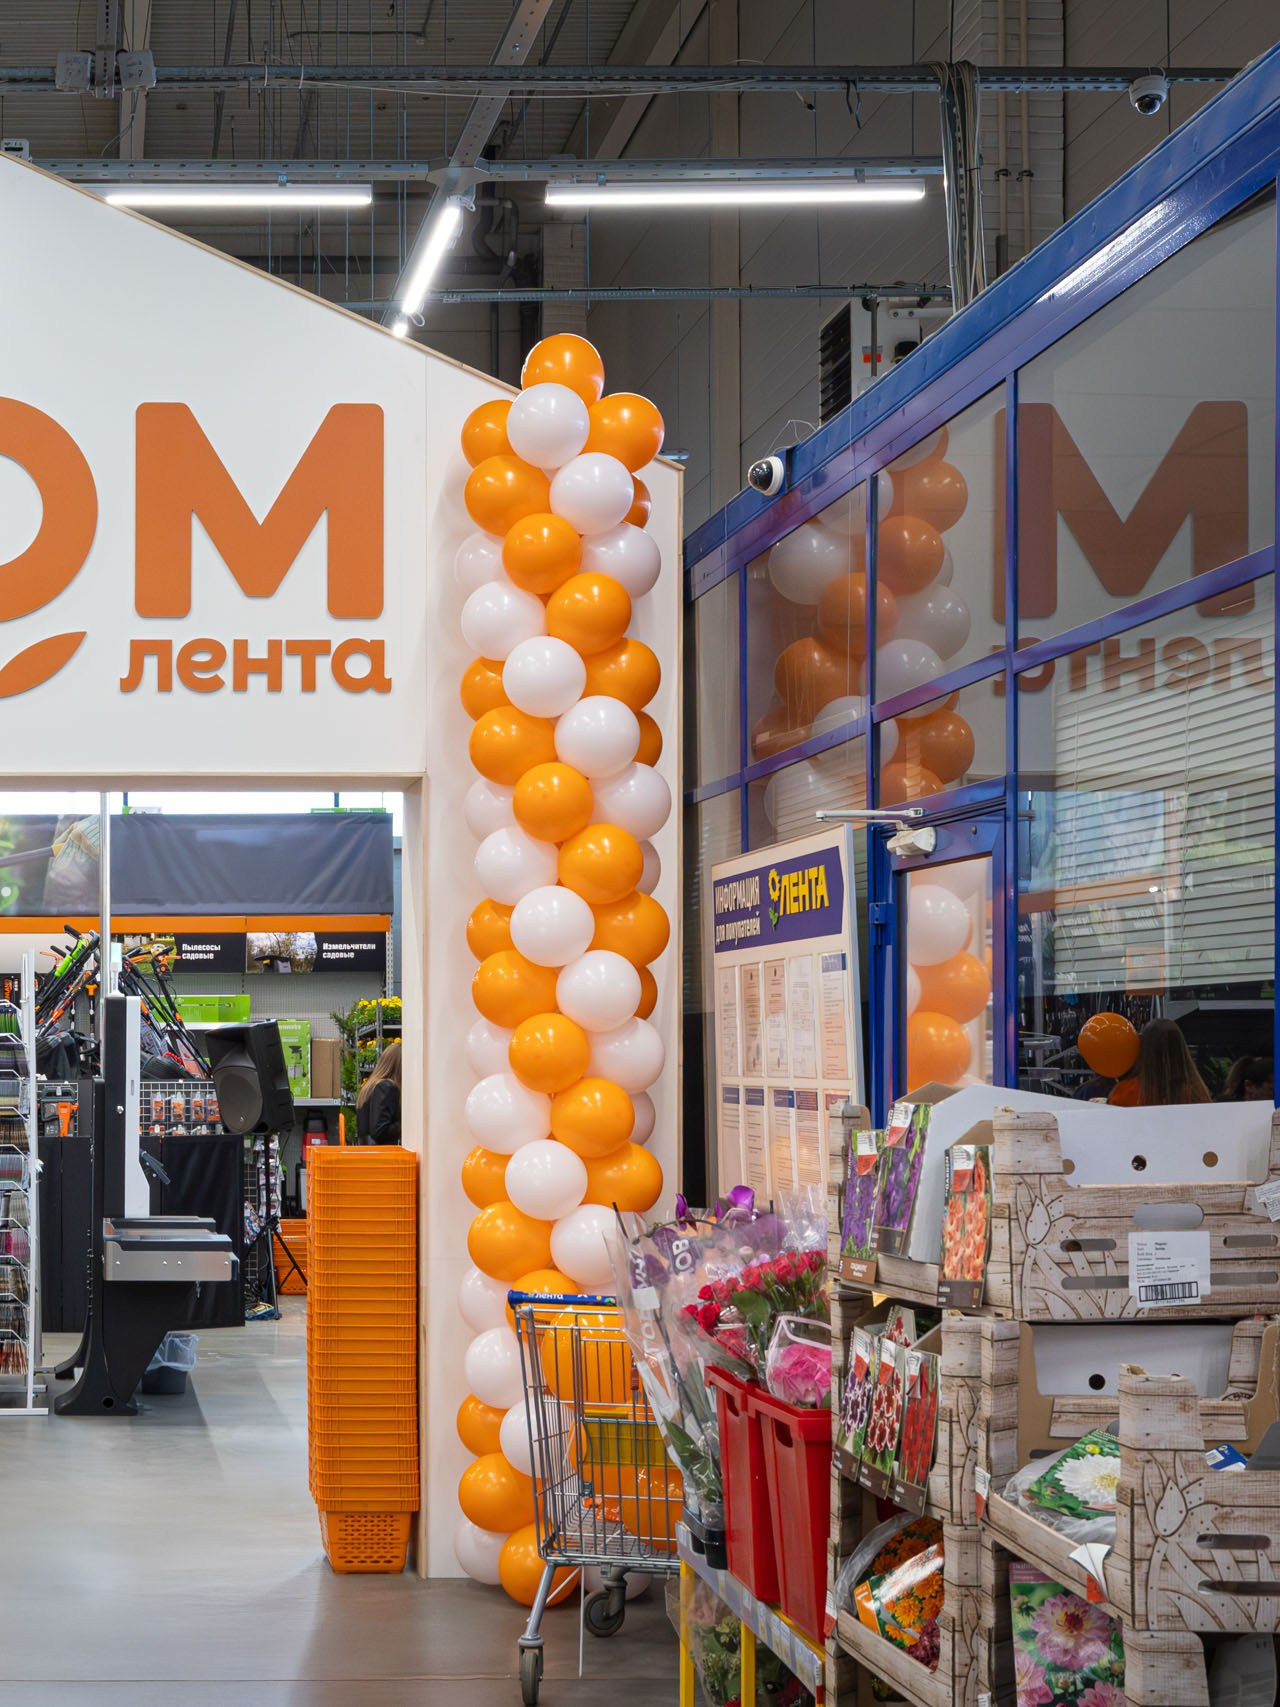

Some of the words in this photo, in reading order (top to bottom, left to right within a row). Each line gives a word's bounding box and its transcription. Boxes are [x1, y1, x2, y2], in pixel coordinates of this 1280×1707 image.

[119, 637, 393, 693] лента
[715, 875, 760, 914] ИНФОРМАЦИЯ
[779, 864, 830, 916] ЛЕНТА
[716, 924, 726, 946] для
[726, 911, 761, 945] покупателей
[182, 943, 221, 951] Пылесосы
[182, 952, 214, 960] садовые
[322, 942, 376, 951] Измельчители
[322, 951, 355, 959] садовые
